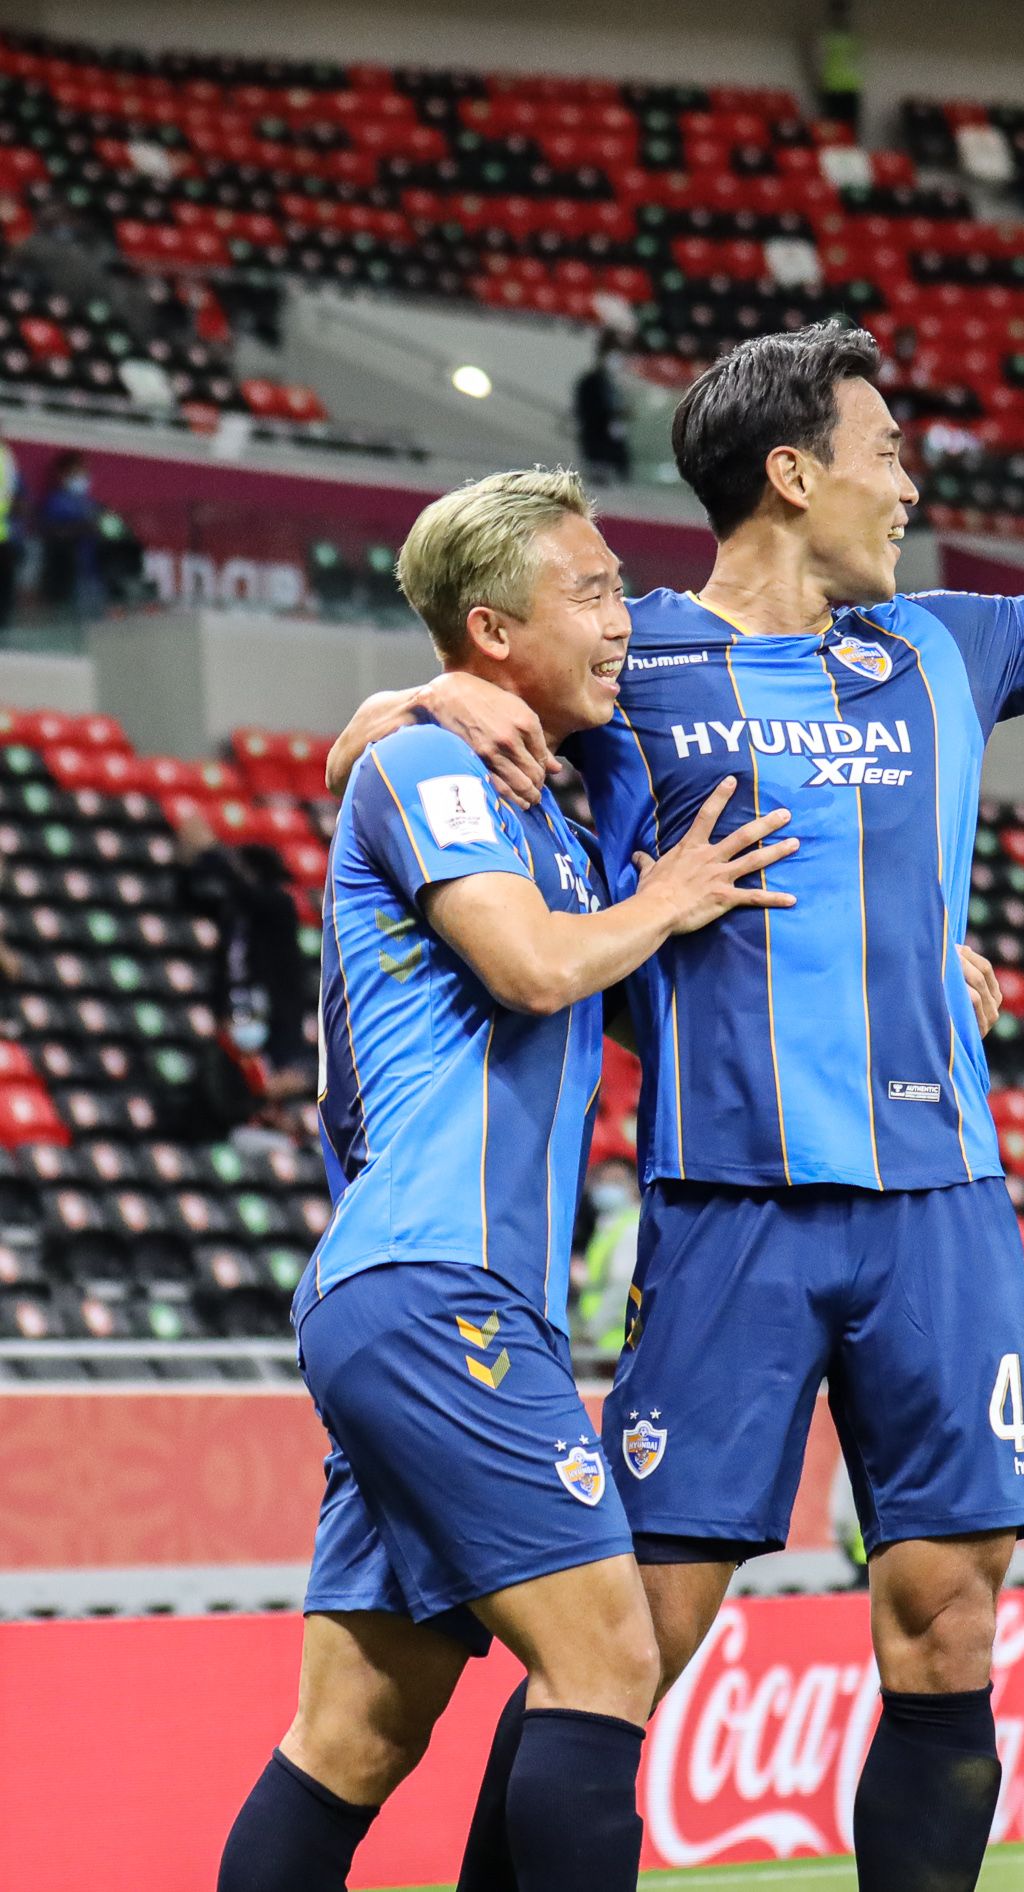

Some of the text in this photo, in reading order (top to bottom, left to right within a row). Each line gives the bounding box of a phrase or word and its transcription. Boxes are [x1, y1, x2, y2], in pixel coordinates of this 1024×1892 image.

[627, 650, 709, 671] hummel
[671, 720, 912, 759] HYUNDAI
[809, 756, 913, 787] XTeer
